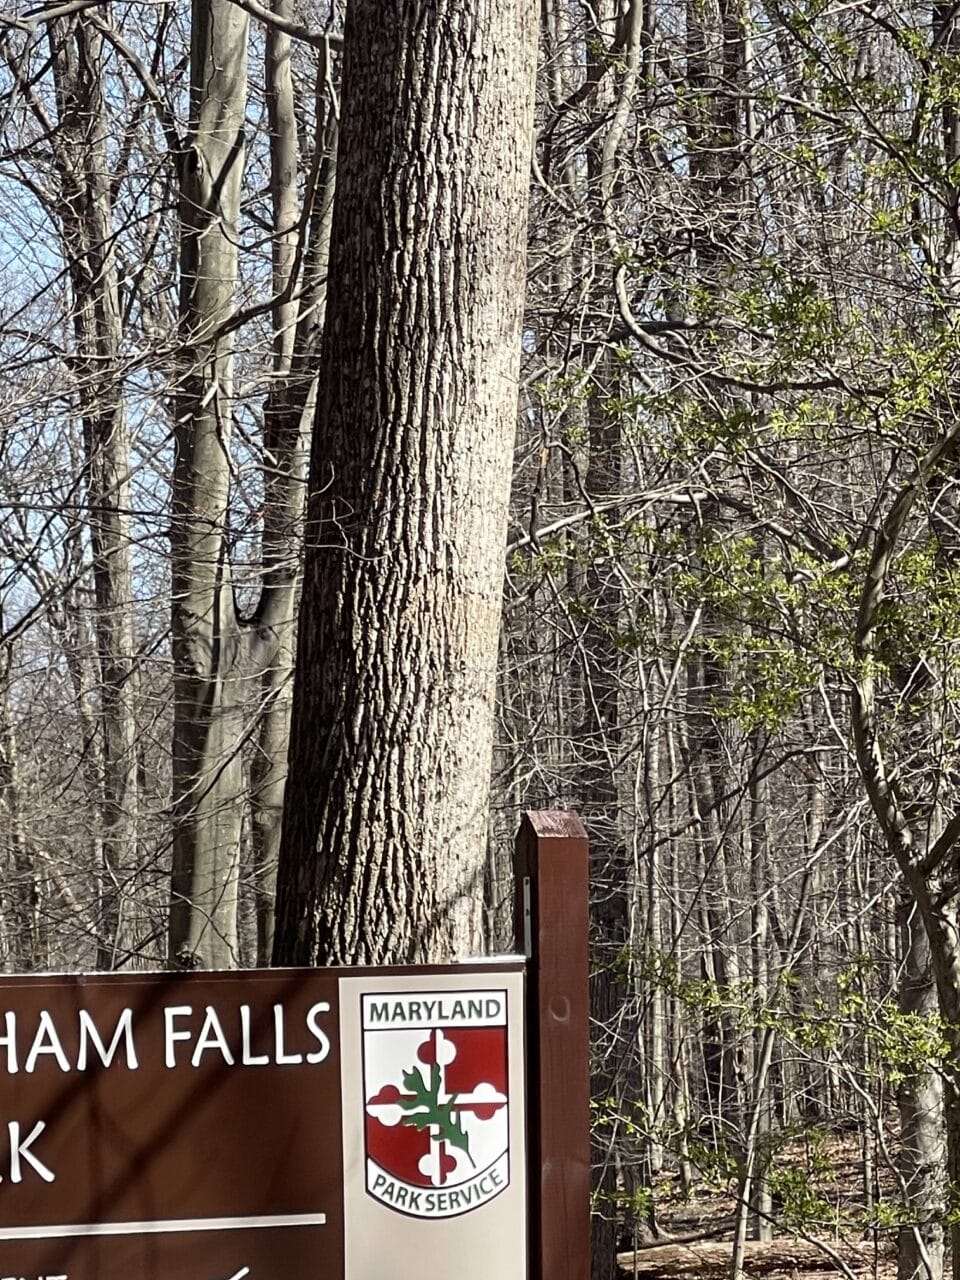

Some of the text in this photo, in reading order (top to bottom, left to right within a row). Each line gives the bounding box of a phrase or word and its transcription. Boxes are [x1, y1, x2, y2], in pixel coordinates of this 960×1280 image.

[369, 998, 501, 1023] MARYLAND
[163, 1001, 331, 1069] FALLS
[372, 1167, 504, 1213] PARK SERVICE
